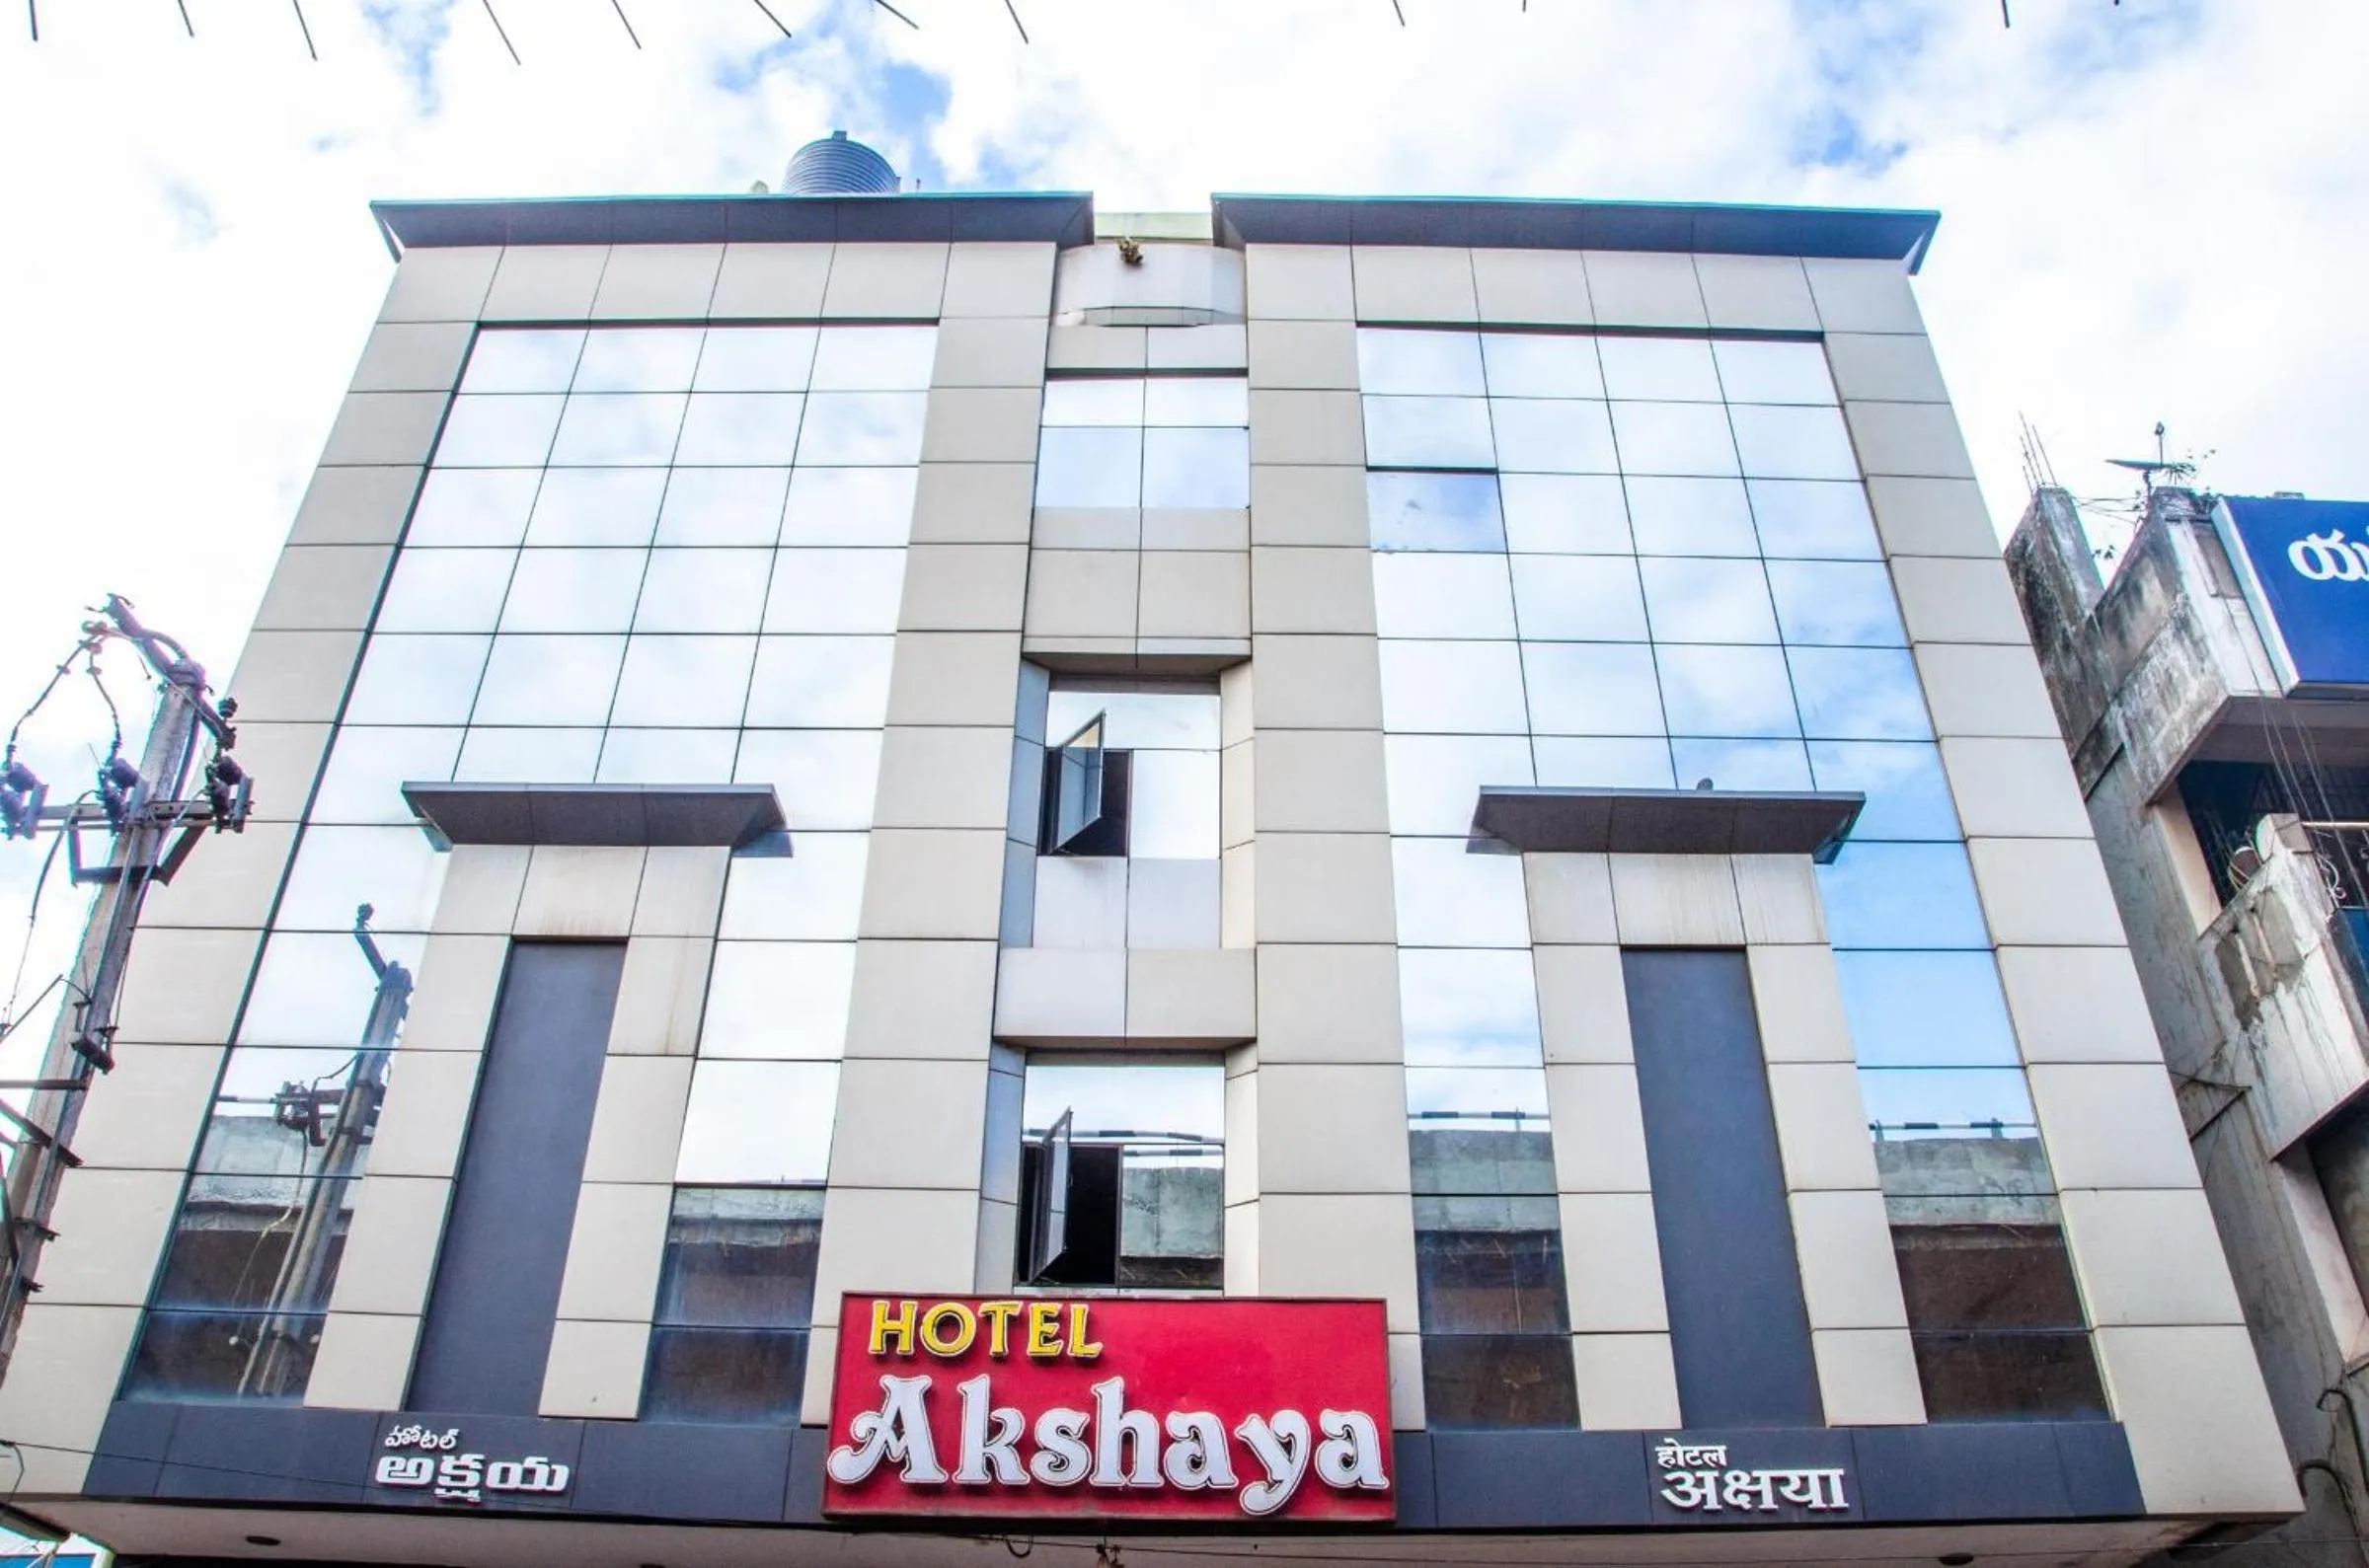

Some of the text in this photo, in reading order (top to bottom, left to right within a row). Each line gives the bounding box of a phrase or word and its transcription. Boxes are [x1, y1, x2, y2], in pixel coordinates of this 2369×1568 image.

[868, 1300, 1104, 1358] HOTEL
[384, 1425, 459, 1450] హోటల్
[827, 1373, 1390, 1517] Akshaya
[1654, 1438, 1727, 1468] होटल
[375, 1454, 570, 1503] అక్షయ
[1659, 1468, 1850, 1511] अक्षया
